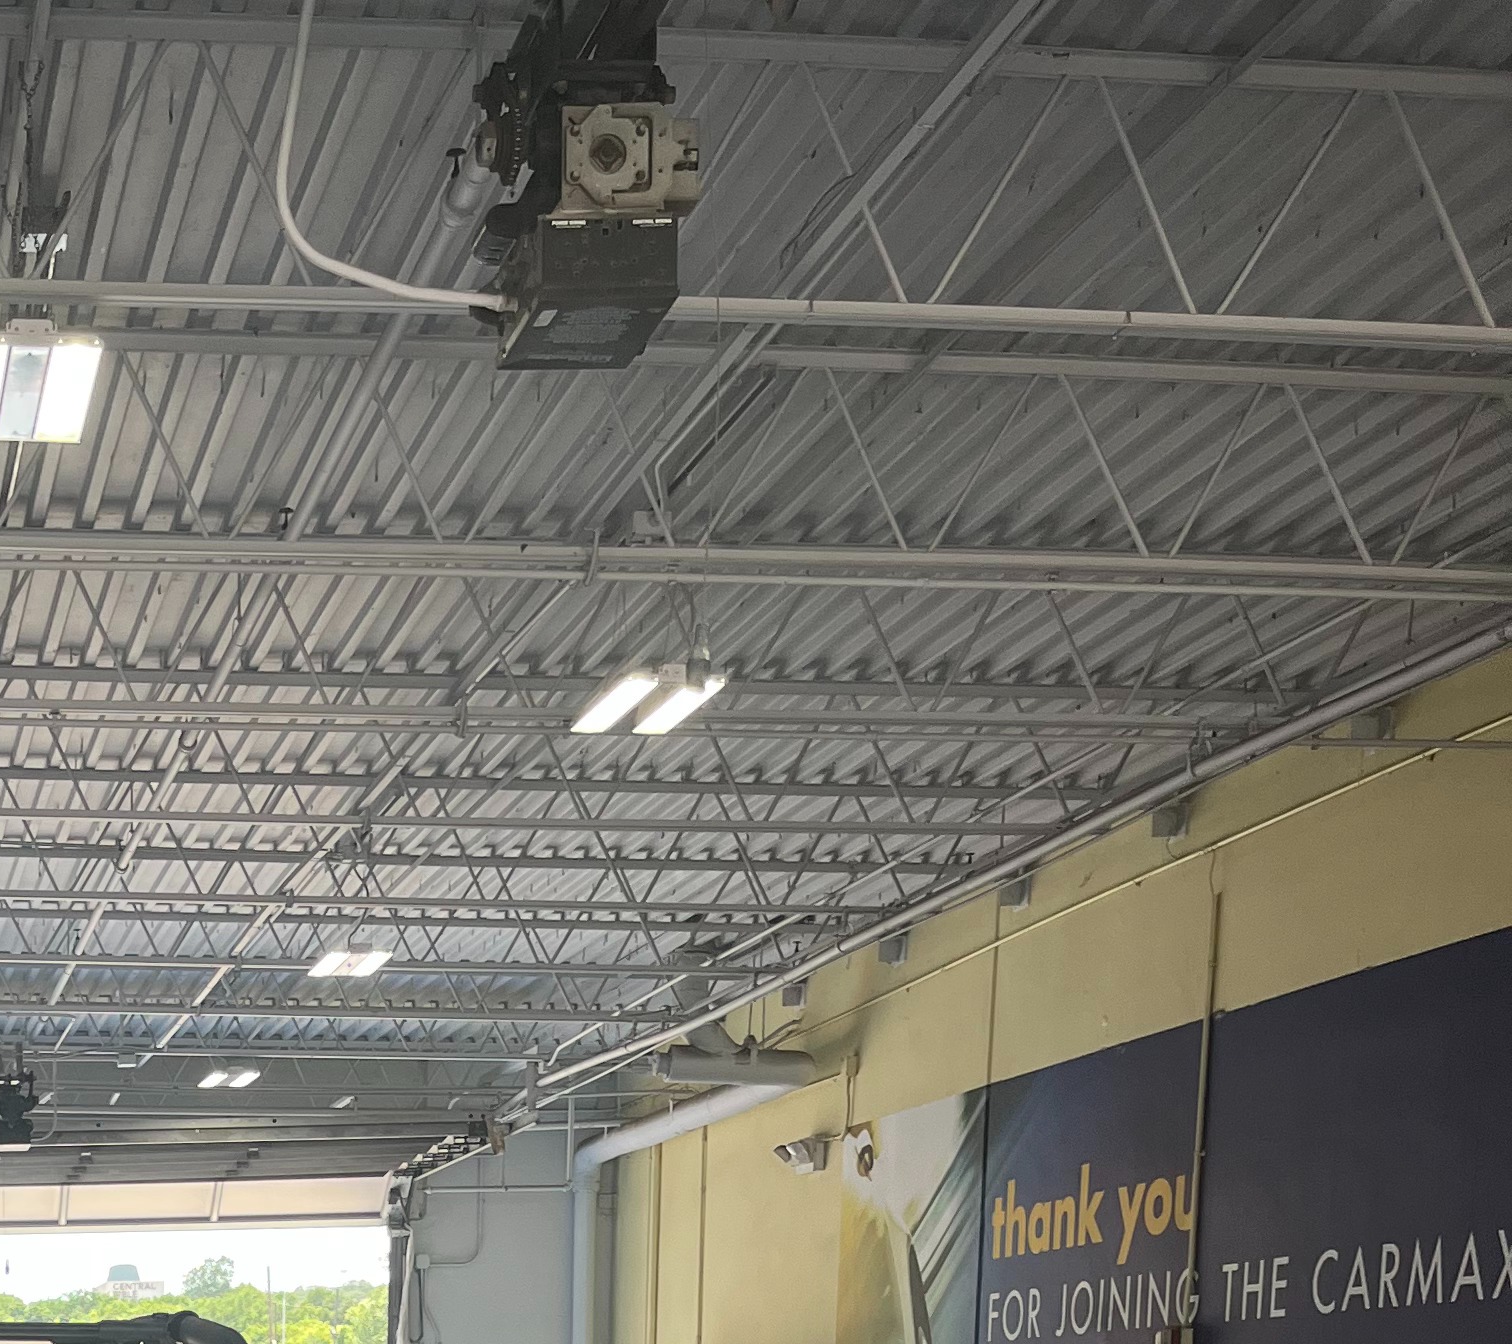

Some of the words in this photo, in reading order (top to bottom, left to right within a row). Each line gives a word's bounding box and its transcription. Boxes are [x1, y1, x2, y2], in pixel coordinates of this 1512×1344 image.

[992, 1163, 1105, 1260] thank
[1117, 1174, 1194, 1265] you
[113, 1282, 157, 1291] CENTRAL
[987, 1288, 1041, 1342] FOR
[1055, 1268, 1200, 1337] JOINING
[1222, 1256, 1290, 1322] THE
